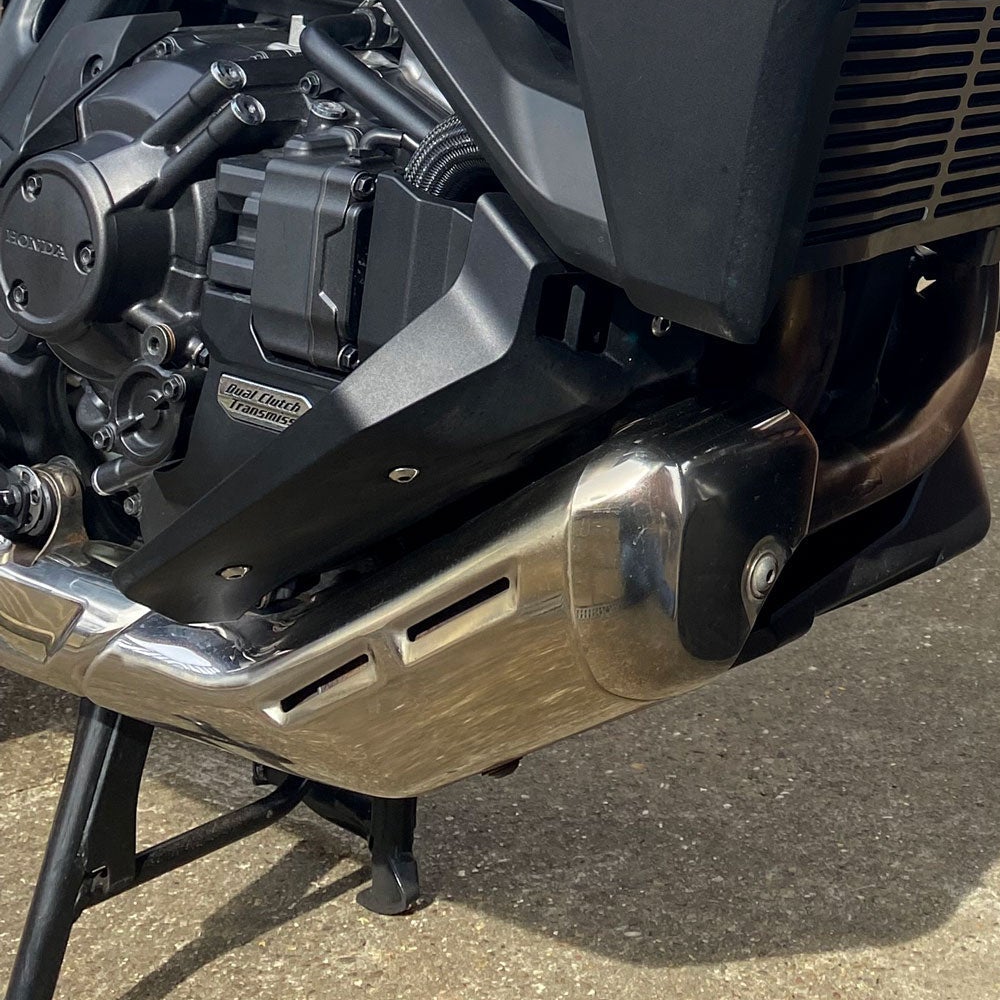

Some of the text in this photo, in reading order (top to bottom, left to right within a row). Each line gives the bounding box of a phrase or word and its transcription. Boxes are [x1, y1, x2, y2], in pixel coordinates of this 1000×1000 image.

[5, 229, 69, 261] HONDA
[225, 383, 301, 413] Dual Clutch
